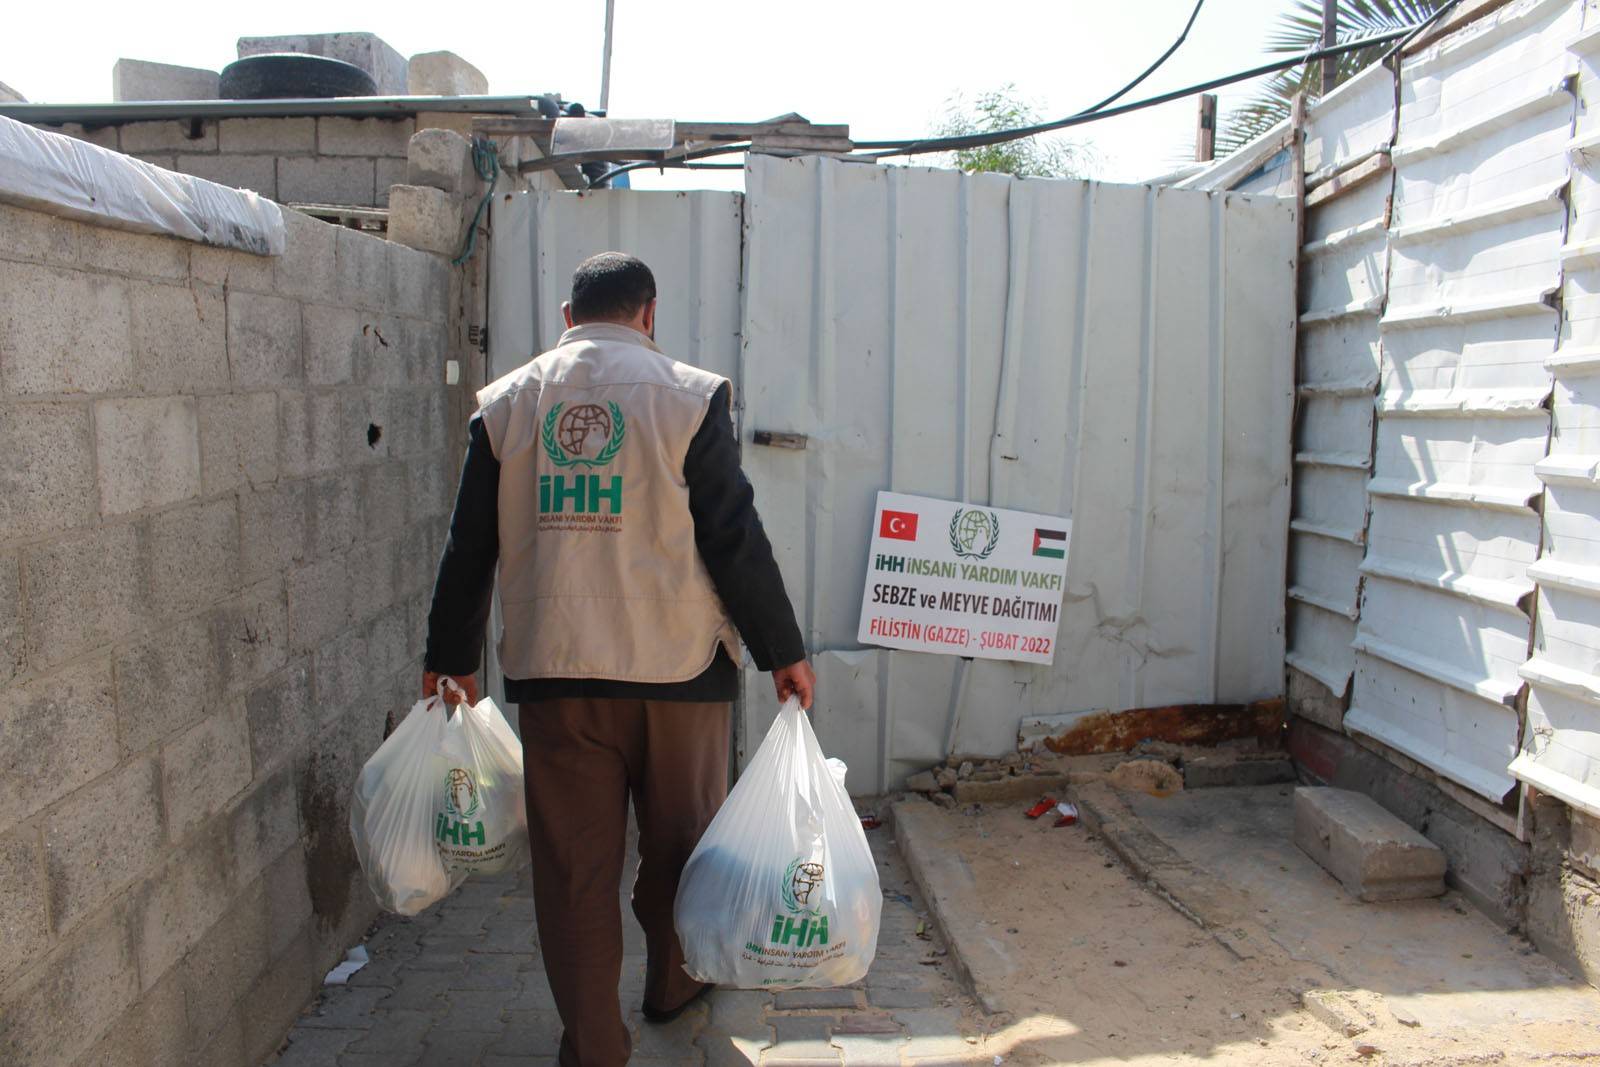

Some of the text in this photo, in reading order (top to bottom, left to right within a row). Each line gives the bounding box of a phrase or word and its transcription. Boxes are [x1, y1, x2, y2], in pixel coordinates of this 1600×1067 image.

[960, 564, 1018, 586] YARDIM
[1021, 570, 1062, 591] VAKFI
[872, 583, 1058, 623] SEBZE ve MEYVE DAĞITIMI
[869, 616, 921, 640] FİLİSTİN
[923, 624, 970, 646] (GAZZE)
[979, 630, 1019, 651] ŞUBAT
[1020, 636, 1051, 654] 2022
